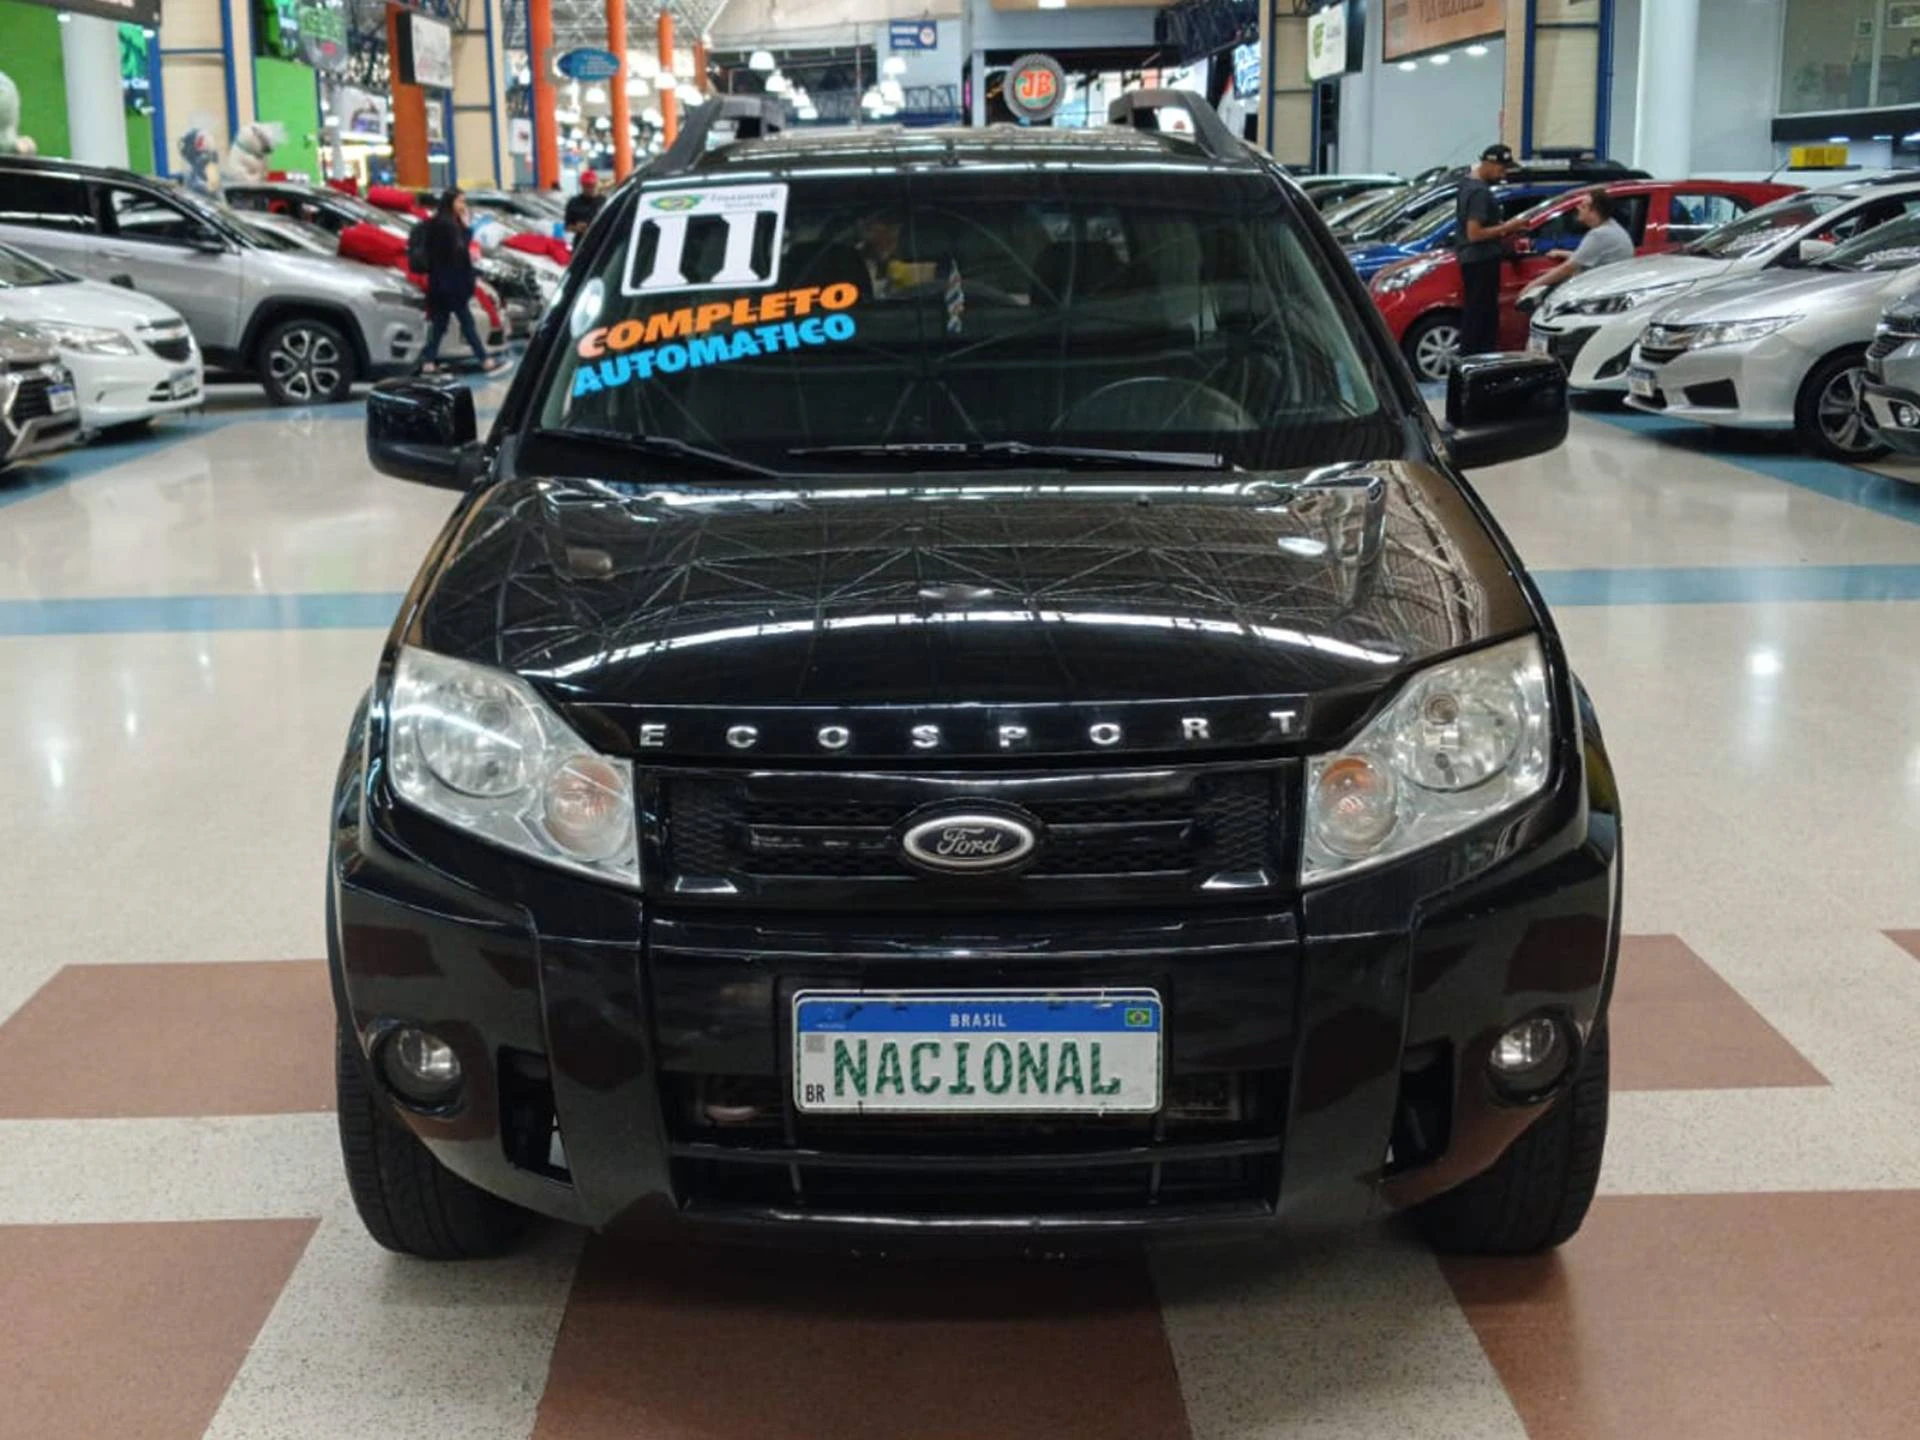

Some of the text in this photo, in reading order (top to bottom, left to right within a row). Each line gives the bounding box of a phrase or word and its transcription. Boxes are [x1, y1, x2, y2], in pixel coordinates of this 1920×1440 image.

[1020, 69, 1053, 98] JB
[642, 211, 762, 287] 11
[577, 282, 859, 359] COMPLETO
[572, 314, 857, 397] AUTOMATICO
[639, 710, 1297, 749] ECOSPORT
[935, 823, 1002, 857] Ford
[949, 1012, 1007, 1028] BRASIL
[833, 1037, 1122, 1097] NACIONAL
[805, 1084, 826, 1104] BR
